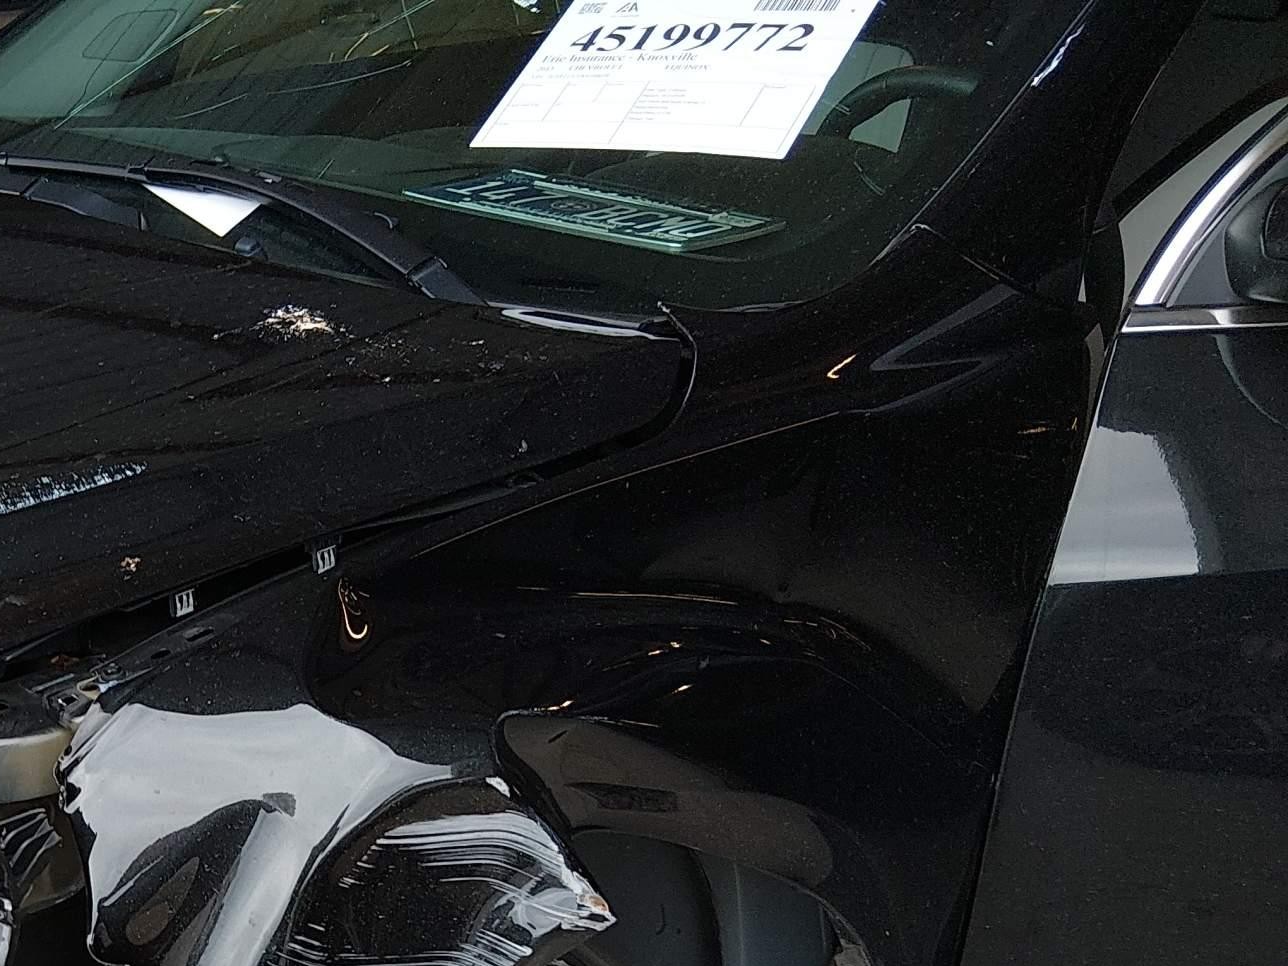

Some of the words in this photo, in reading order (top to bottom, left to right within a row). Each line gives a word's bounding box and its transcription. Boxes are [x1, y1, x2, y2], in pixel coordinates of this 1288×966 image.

[570, 22, 814, 51] 45199772
[569, 54, 626, 62] Insurance
[637, 52, 698, 61] Knoxville
